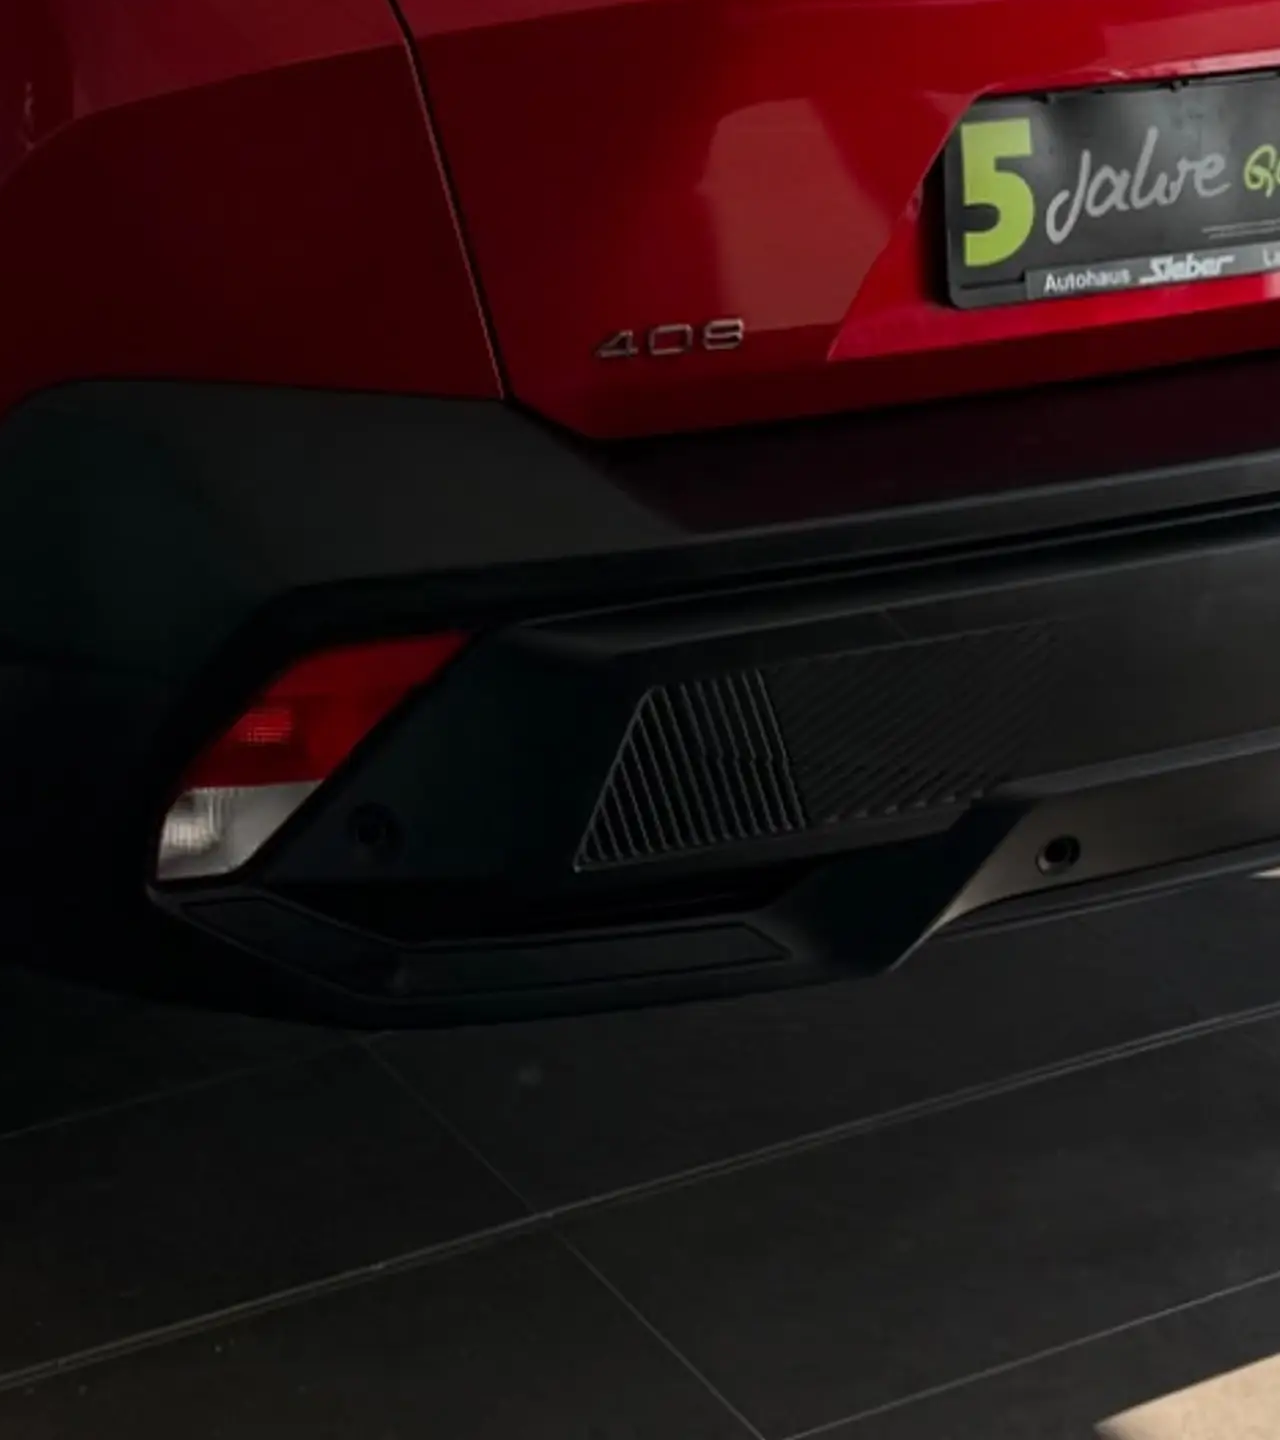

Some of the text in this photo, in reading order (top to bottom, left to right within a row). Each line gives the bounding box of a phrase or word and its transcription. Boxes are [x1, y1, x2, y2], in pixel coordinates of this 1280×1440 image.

[961, 117, 1035, 267] 5
[1045, 126, 1232, 244] Jahre
[1043, 267, 1131, 294] Autohaus
[1138, 253, 1235, 284] Sieber
[597, 318, 744, 357] 408
